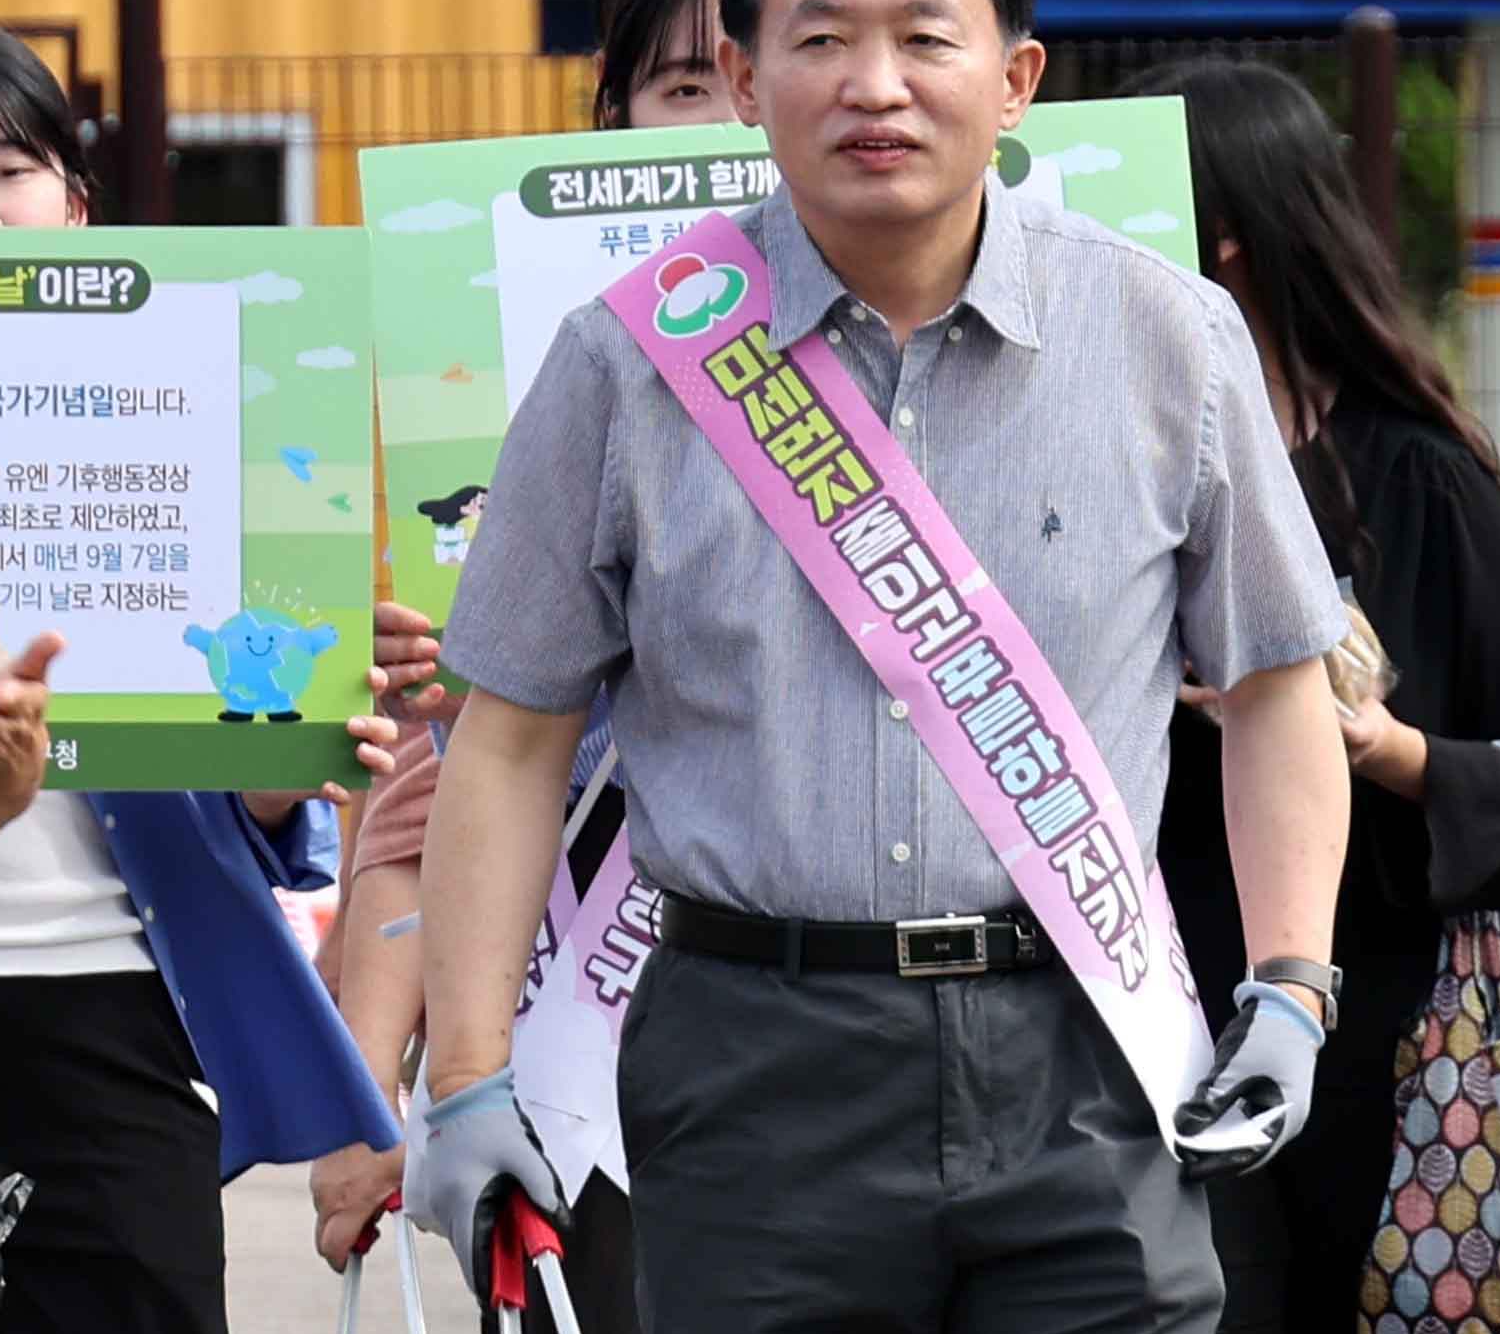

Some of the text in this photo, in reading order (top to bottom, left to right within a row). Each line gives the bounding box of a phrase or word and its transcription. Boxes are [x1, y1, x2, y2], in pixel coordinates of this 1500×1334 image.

[549, 164, 698, 211] 전세계가
[600, 224, 652, 257] 푸른
[4, 464, 50, 493] 유엔
[56, 463, 191, 493] 기후행동정상
[69, 502, 189, 534] 제안하였고,
[33, 542, 79, 572] 매년
[85, 543, 123, 573] 9월
[131, 543, 190, 573] 7일을
[49, 582, 94, 612] 날로
[99, 581, 189, 612] 지정하는
[832, 497, 976, 665] 줄이고
